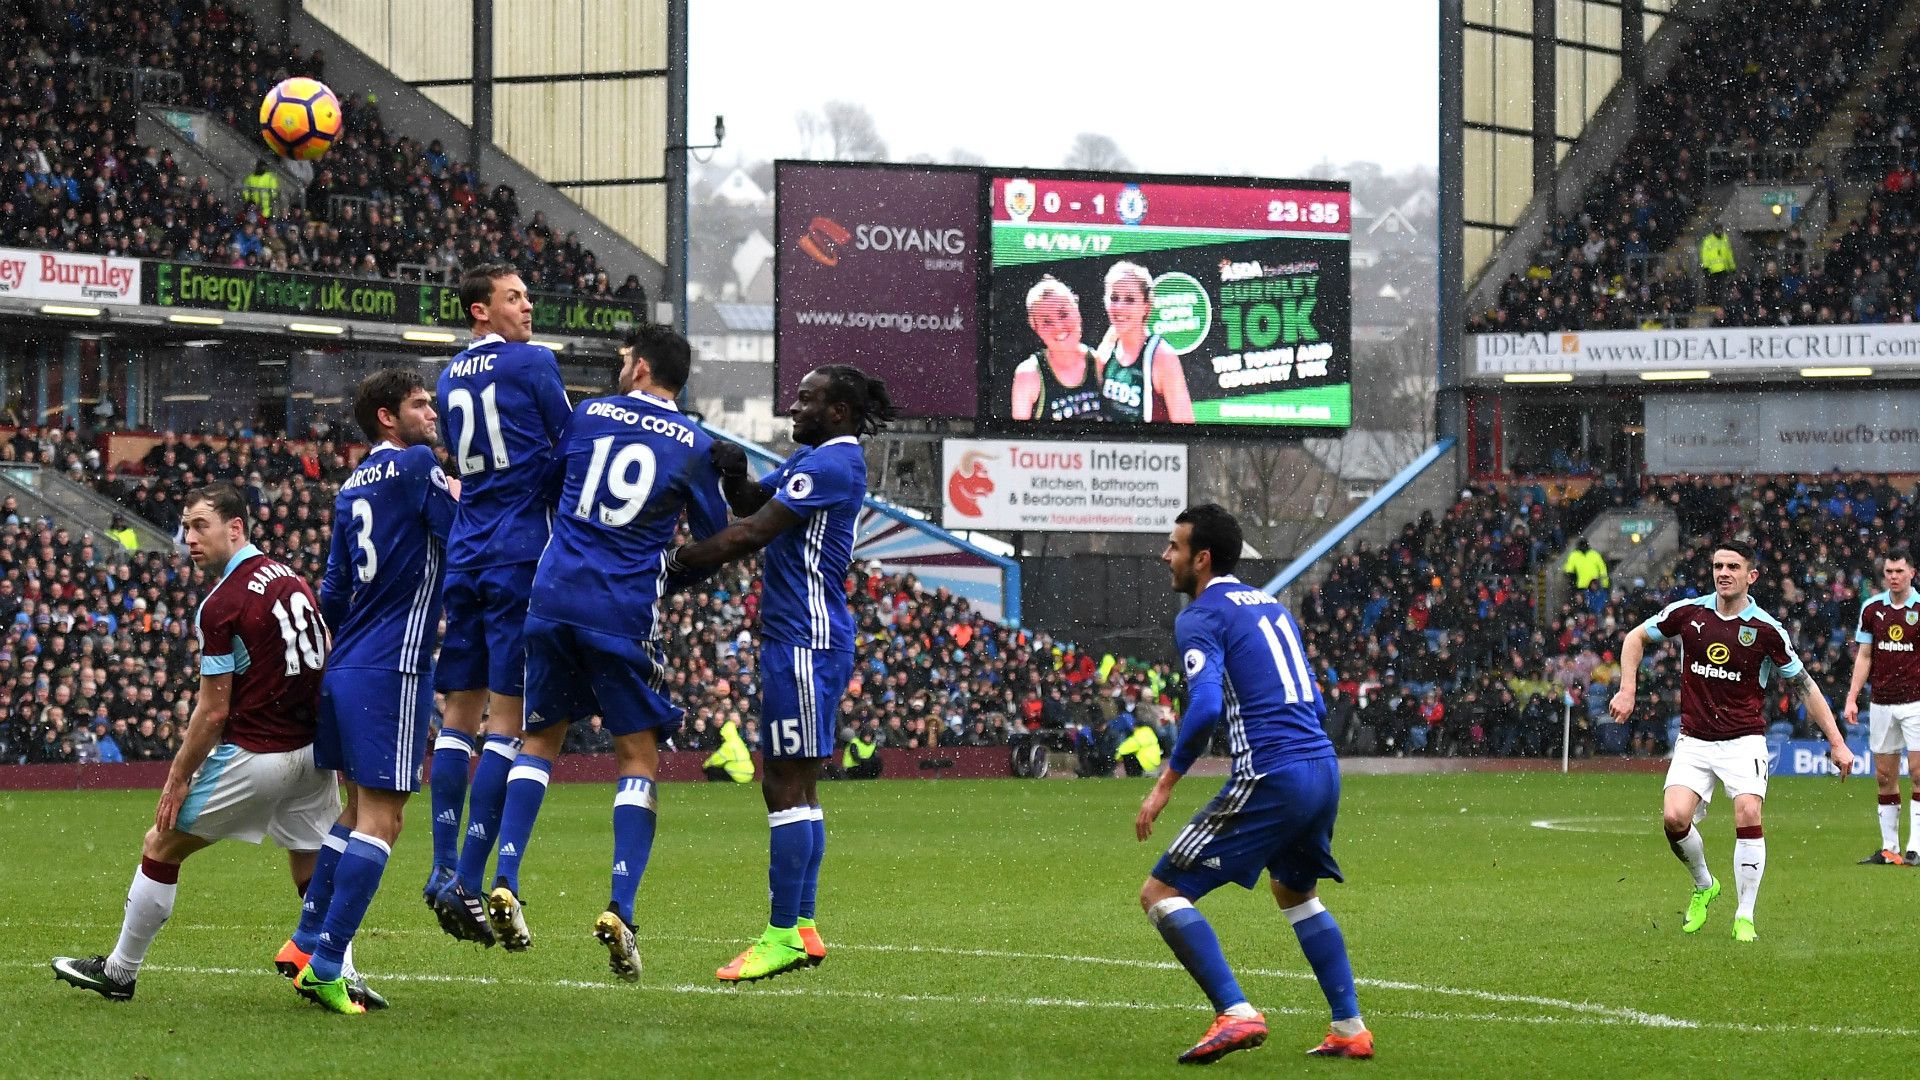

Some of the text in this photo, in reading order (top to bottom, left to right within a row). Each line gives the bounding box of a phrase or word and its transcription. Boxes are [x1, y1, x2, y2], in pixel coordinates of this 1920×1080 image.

[1043, 193, 1061, 214] 0
[1092, 194, 1105, 215] 1
[1267, 200, 1340, 224] 23:35
[855, 223, 966, 254] SOYANG
[40, 254, 133, 295] Burnley
[796, 307, 965, 332] www.soyang.co.uk
[1221, 298, 1320, 350] 10K
[1485, 334, 1557, 356] IDEAL
[1587, 333, 1920, 361] www.IDEAL-RECRUIT.com
[450, 354, 497, 378] MATIC
[1102, 379, 1142, 407] EEDS
[448, 382, 510, 476] 21
[586, 402, 695, 448] DIEGO COSTA
[1780, 424, 1920, 445] www.ucfb.com
[1009, 447, 1181, 472] Taurus Interiors
[340, 460, 400, 491] MARCOS A.
[573, 435, 657, 527] 19
[1031, 477, 1159, 491] Kitchen, Bathroom
[1009, 492, 1181, 508] & Bedroom Manufacture
[352, 499, 378, 583] 3
[272, 591, 325, 676] 10
[1878, 640, 1914, 652] dafabet
[1258, 613, 1314, 704] 11
[1690, 661, 1742, 681] dafabet
[770, 718, 801, 757] 15
